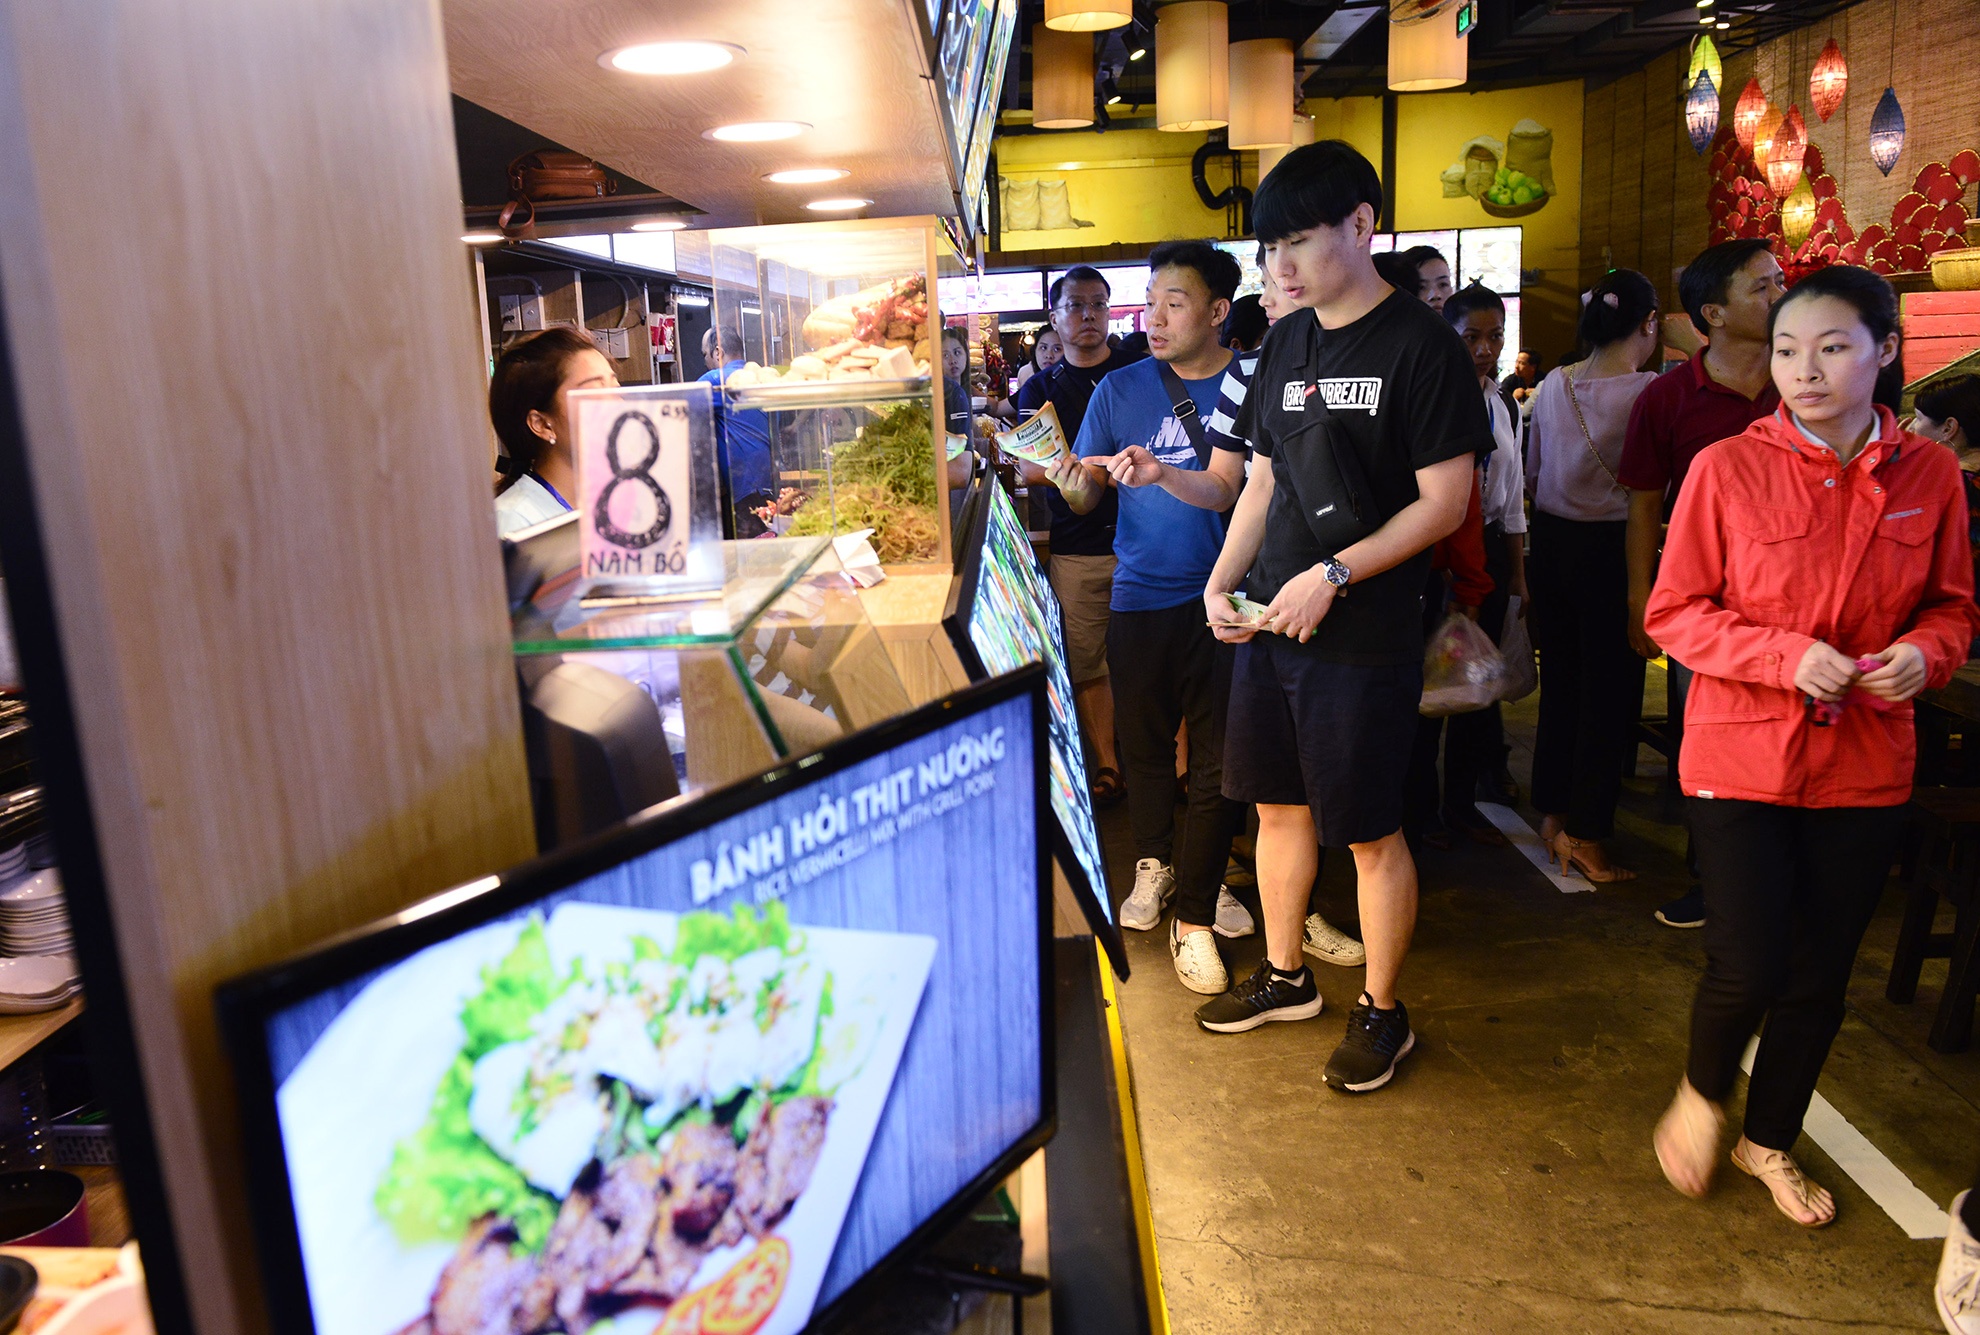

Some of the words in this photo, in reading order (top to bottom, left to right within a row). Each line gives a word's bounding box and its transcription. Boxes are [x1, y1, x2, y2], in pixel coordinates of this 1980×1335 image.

[1286, 382, 1377, 407] BRONBREATH
[594, 409, 672, 550] 8
[587, 551, 642, 575] NAM
[690, 825, 785, 904] BÁNH
[790, 793, 848, 857] HỎI
[851, 766, 914, 826] THỊT
